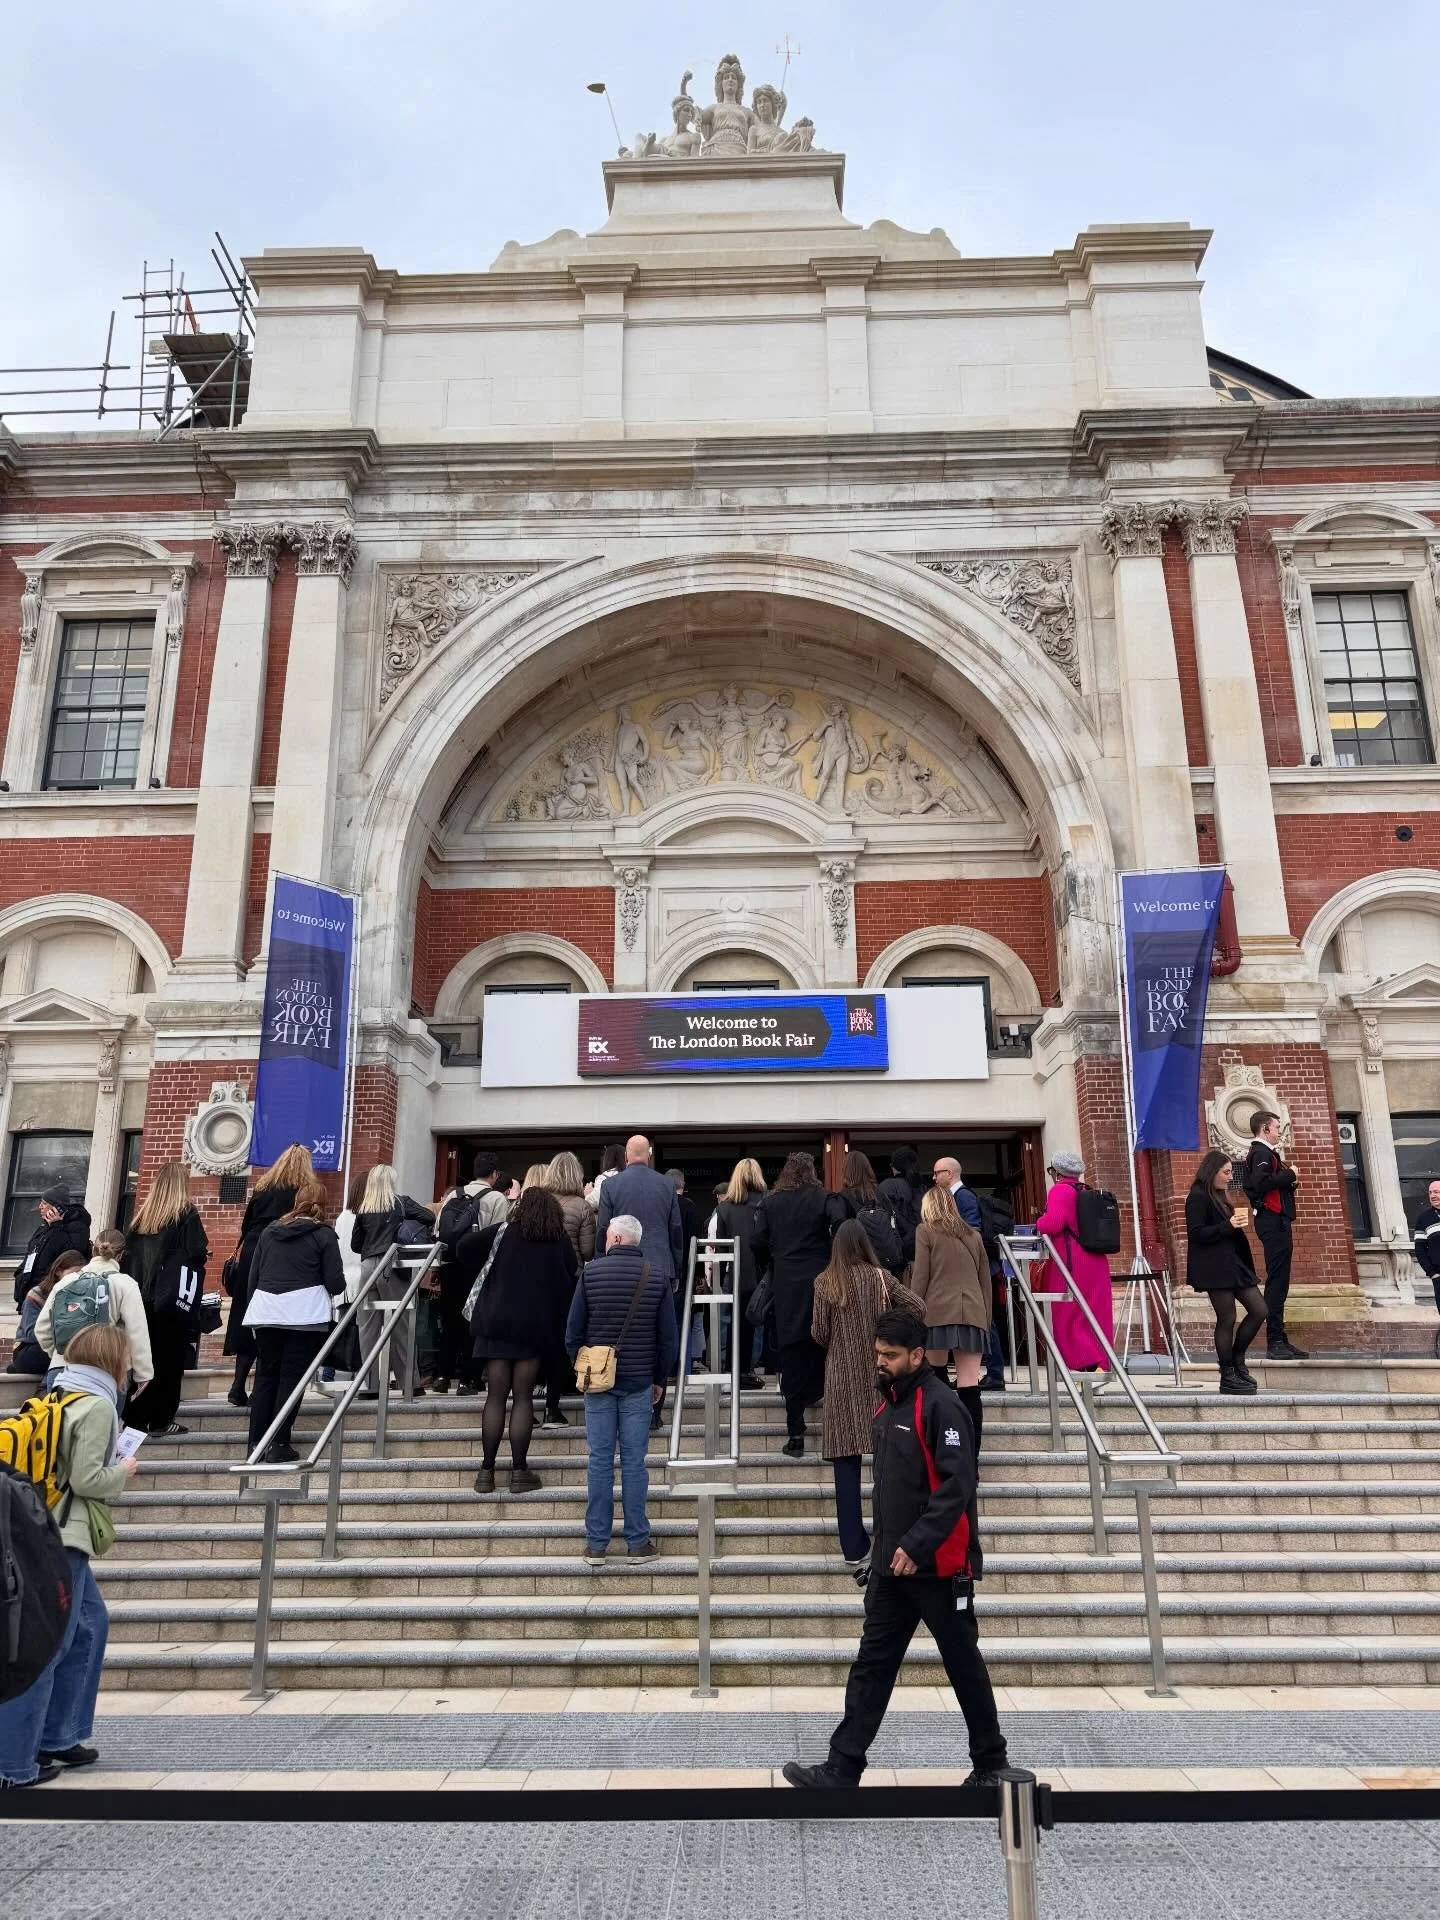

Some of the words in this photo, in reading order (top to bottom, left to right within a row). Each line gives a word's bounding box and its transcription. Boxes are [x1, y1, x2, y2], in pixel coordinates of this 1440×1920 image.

[1133, 900, 1201, 913] Welcome
[686, 1016, 758, 1030] Welcome
[760, 1016, 778, 1029] to
[850, 1016, 874, 1025] BOOK
[850, 1023, 873, 1032] FAIR
[588, 1041, 609, 1054] RX
[649, 1035, 676, 1049] The
[680, 1034, 738, 1049] London
[741, 1034, 782, 1047] Book
[785, 1033, 816, 1047] Fair
